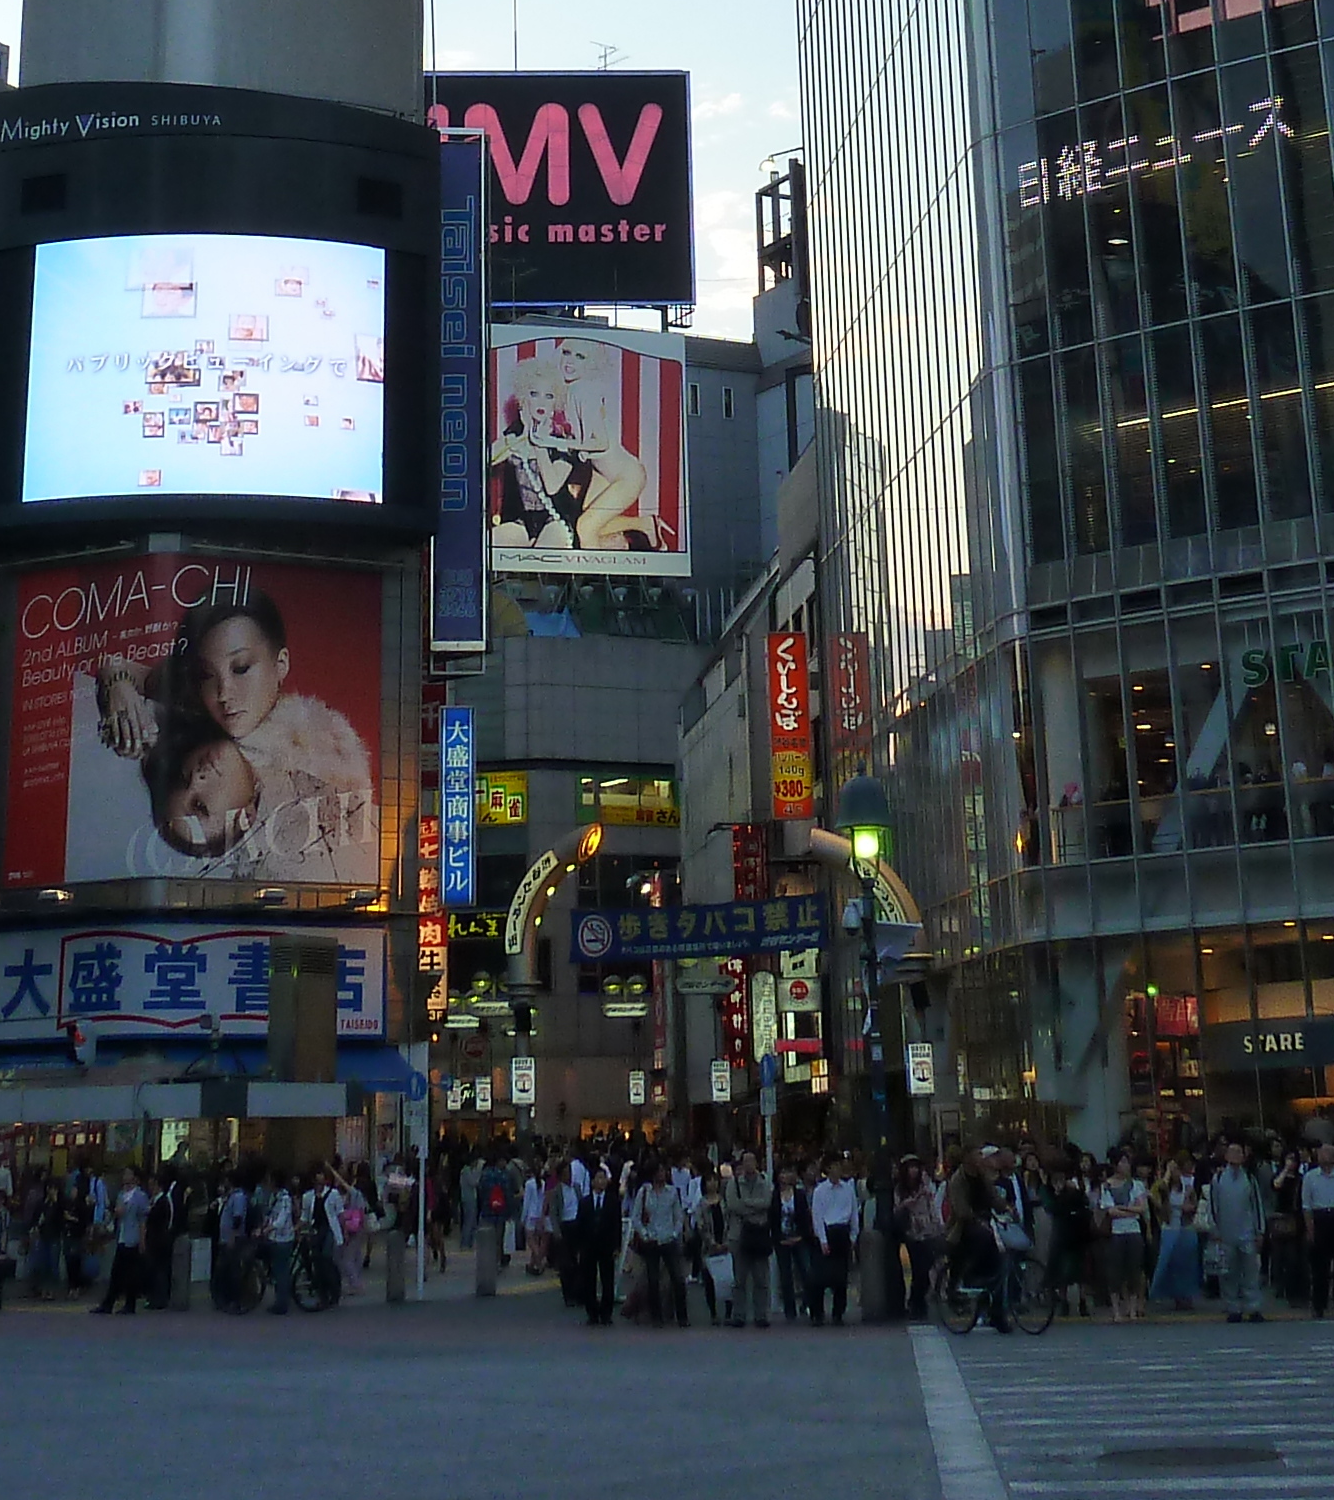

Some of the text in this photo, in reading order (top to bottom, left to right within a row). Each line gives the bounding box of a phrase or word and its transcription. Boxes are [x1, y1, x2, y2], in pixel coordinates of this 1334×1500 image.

[0, 110, 223, 144] Mighty Vision SHIBUYA
[1017, 94, 1296, 209] 日経ニュース
[547, 217, 667, 244] master
[65, 350, 349, 378] パブリックビューイングで
[440, 373, 470, 514] neon
[21, 563, 251, 639] COMA-CHI
[21, 630, 109, 668] 2nd ALBUM
[21, 665, 75, 688] Beauty
[97, 650, 123, 669] the
[445, 720, 470, 893] 大盛堂商事ビル
[617, 899, 821, 941] 歩きタバコ禁止
